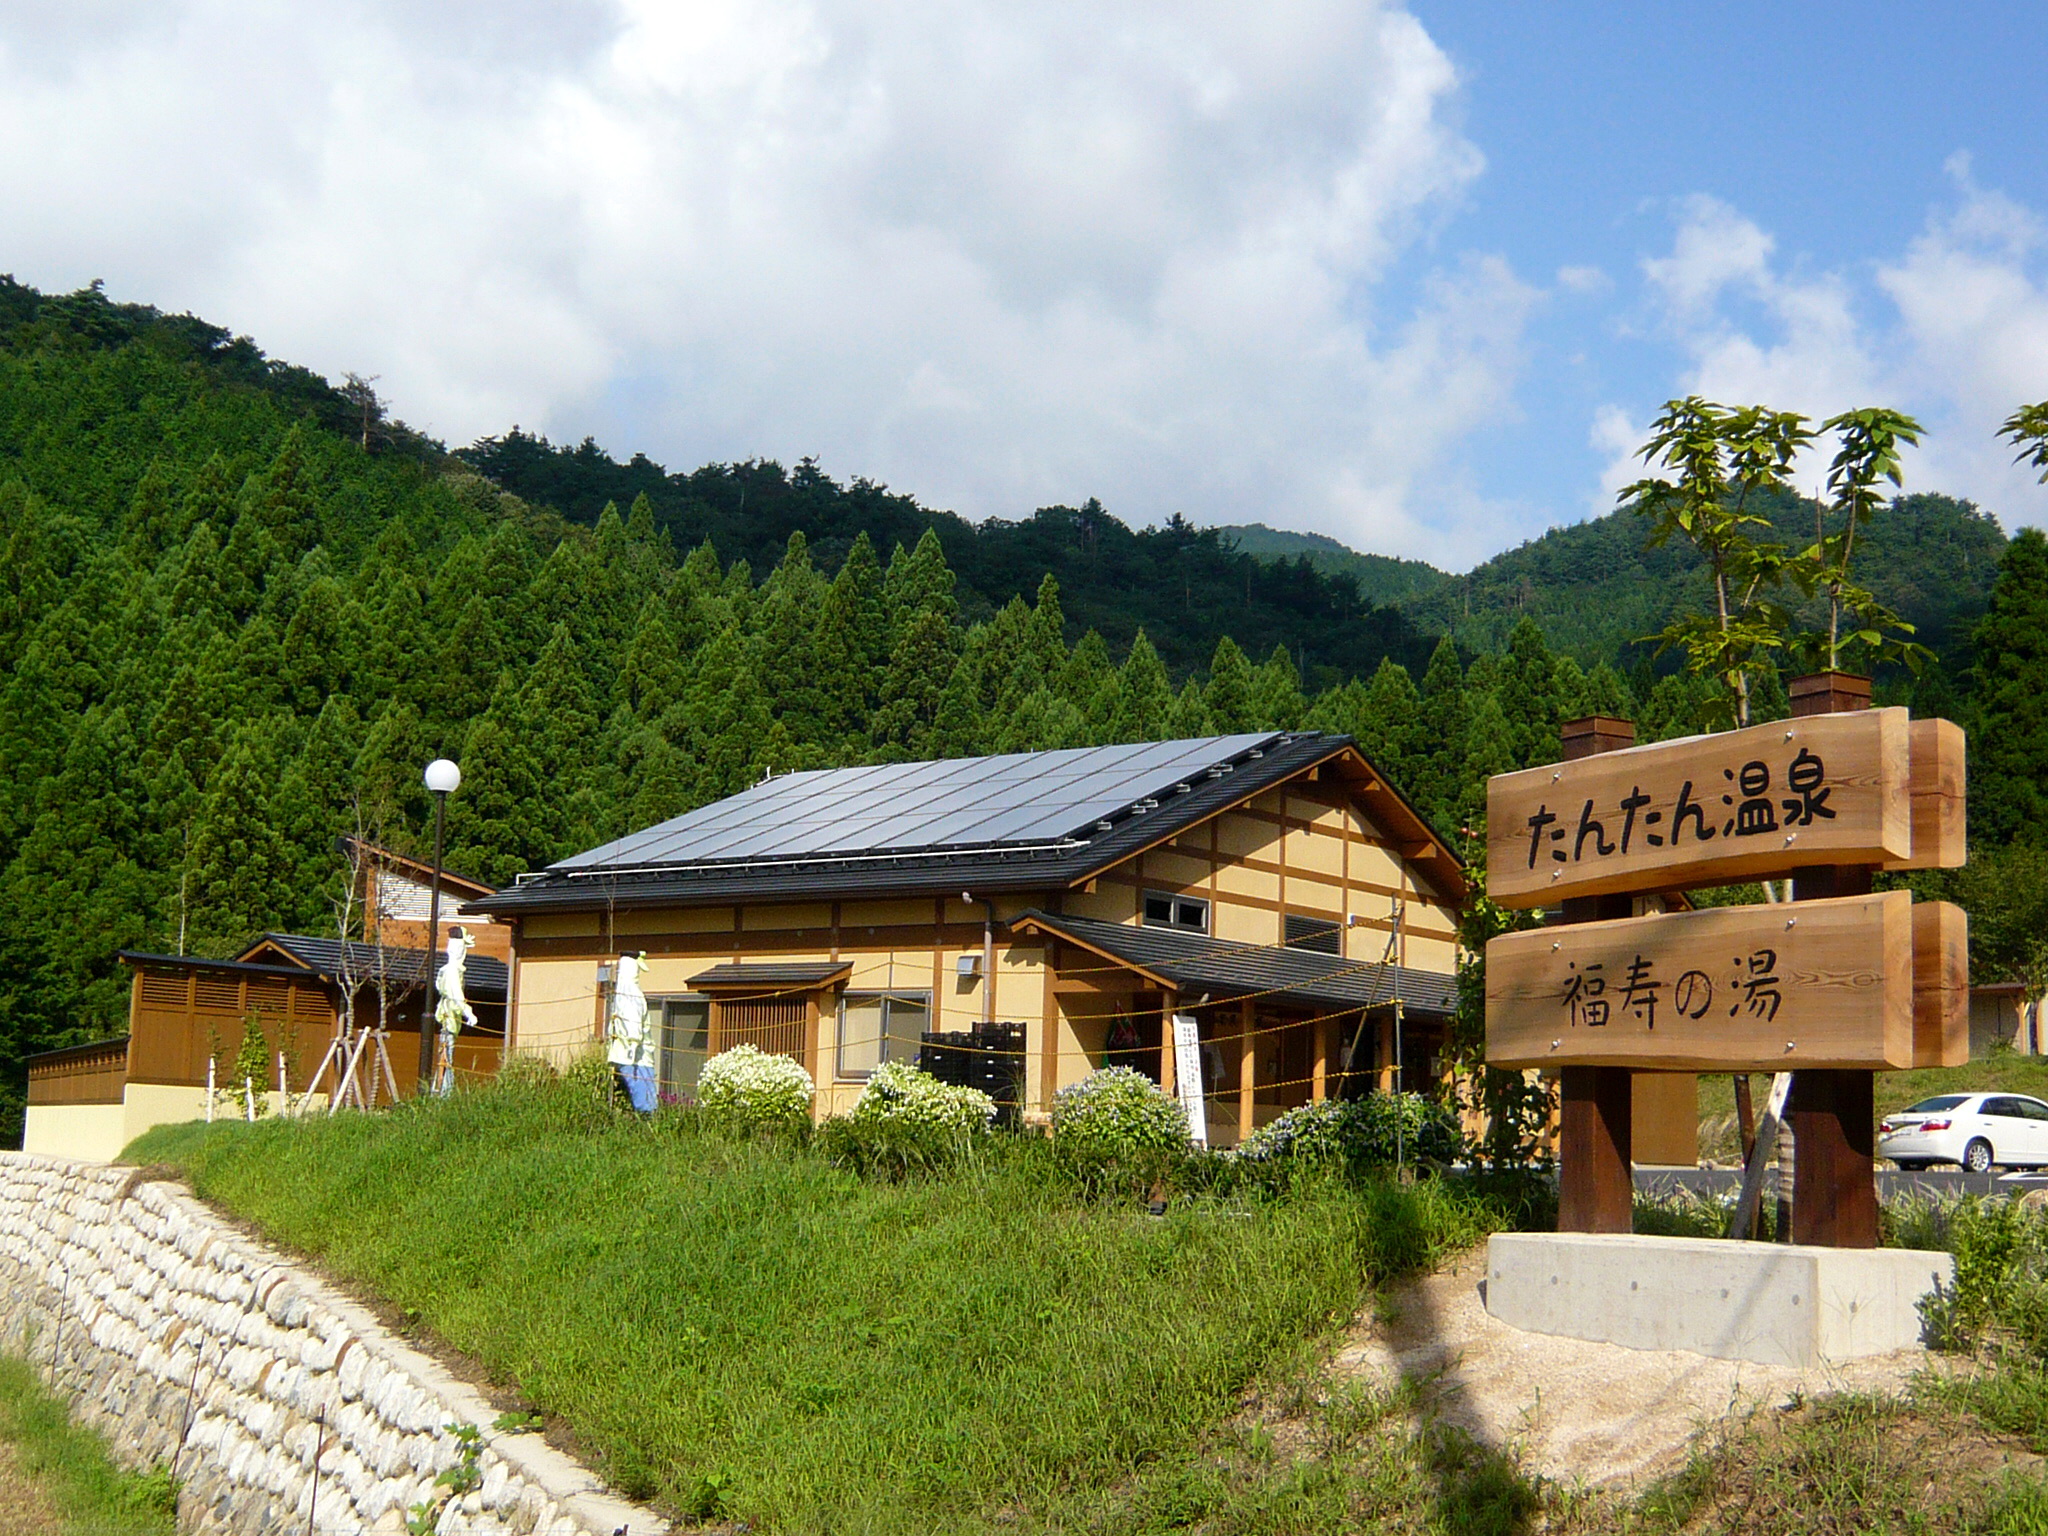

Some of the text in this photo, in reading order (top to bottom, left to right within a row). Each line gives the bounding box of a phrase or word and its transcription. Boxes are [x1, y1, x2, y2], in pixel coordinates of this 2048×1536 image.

[1529, 748, 1837, 869] たんたん温泉
[1563, 949, 1782, 1030] 福寿の湯
